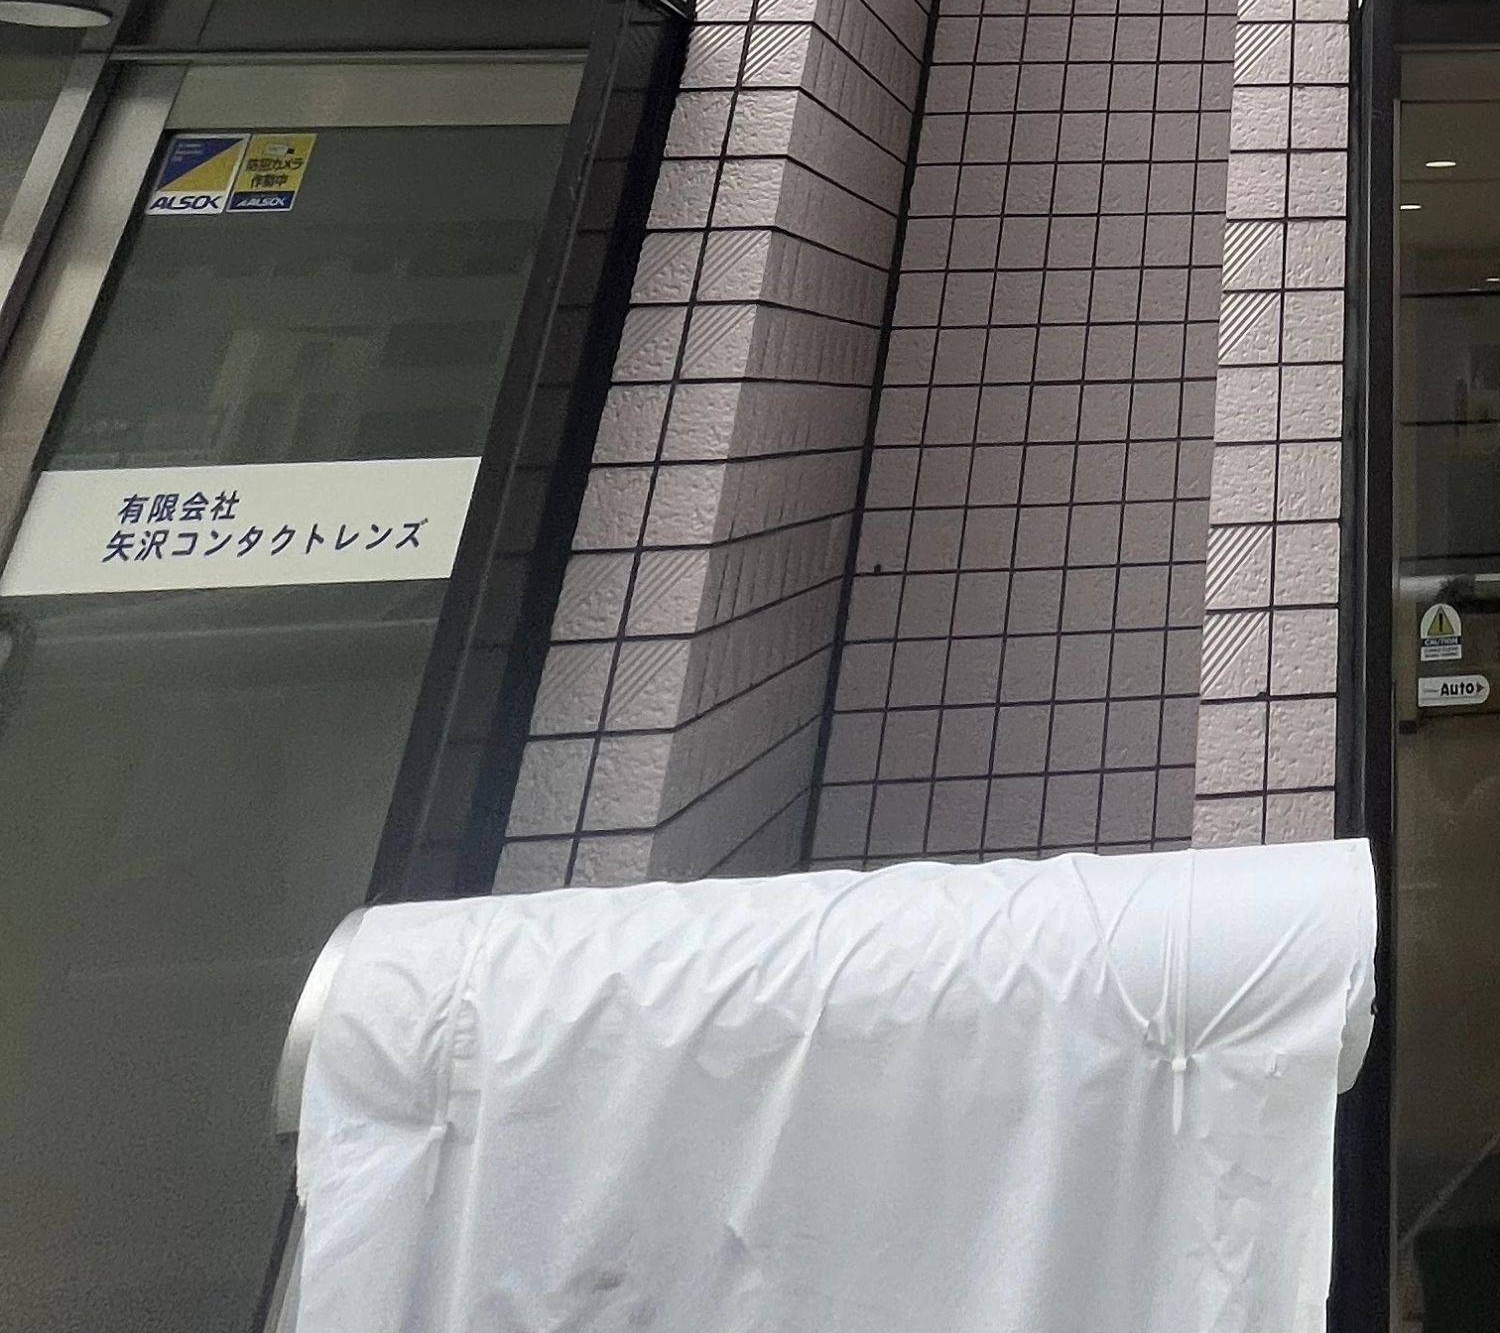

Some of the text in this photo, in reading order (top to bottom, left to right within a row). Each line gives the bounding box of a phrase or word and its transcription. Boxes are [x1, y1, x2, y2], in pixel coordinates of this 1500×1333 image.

[150, 196, 222, 210] ALSOK
[117, 490, 240, 525] 有限会社
[102, 518, 429, 563] 矢沢コンタクトレンズ
[1424, 638, 1458, 646] CAUTION
[1441, 683, 1475, 696] Auto
